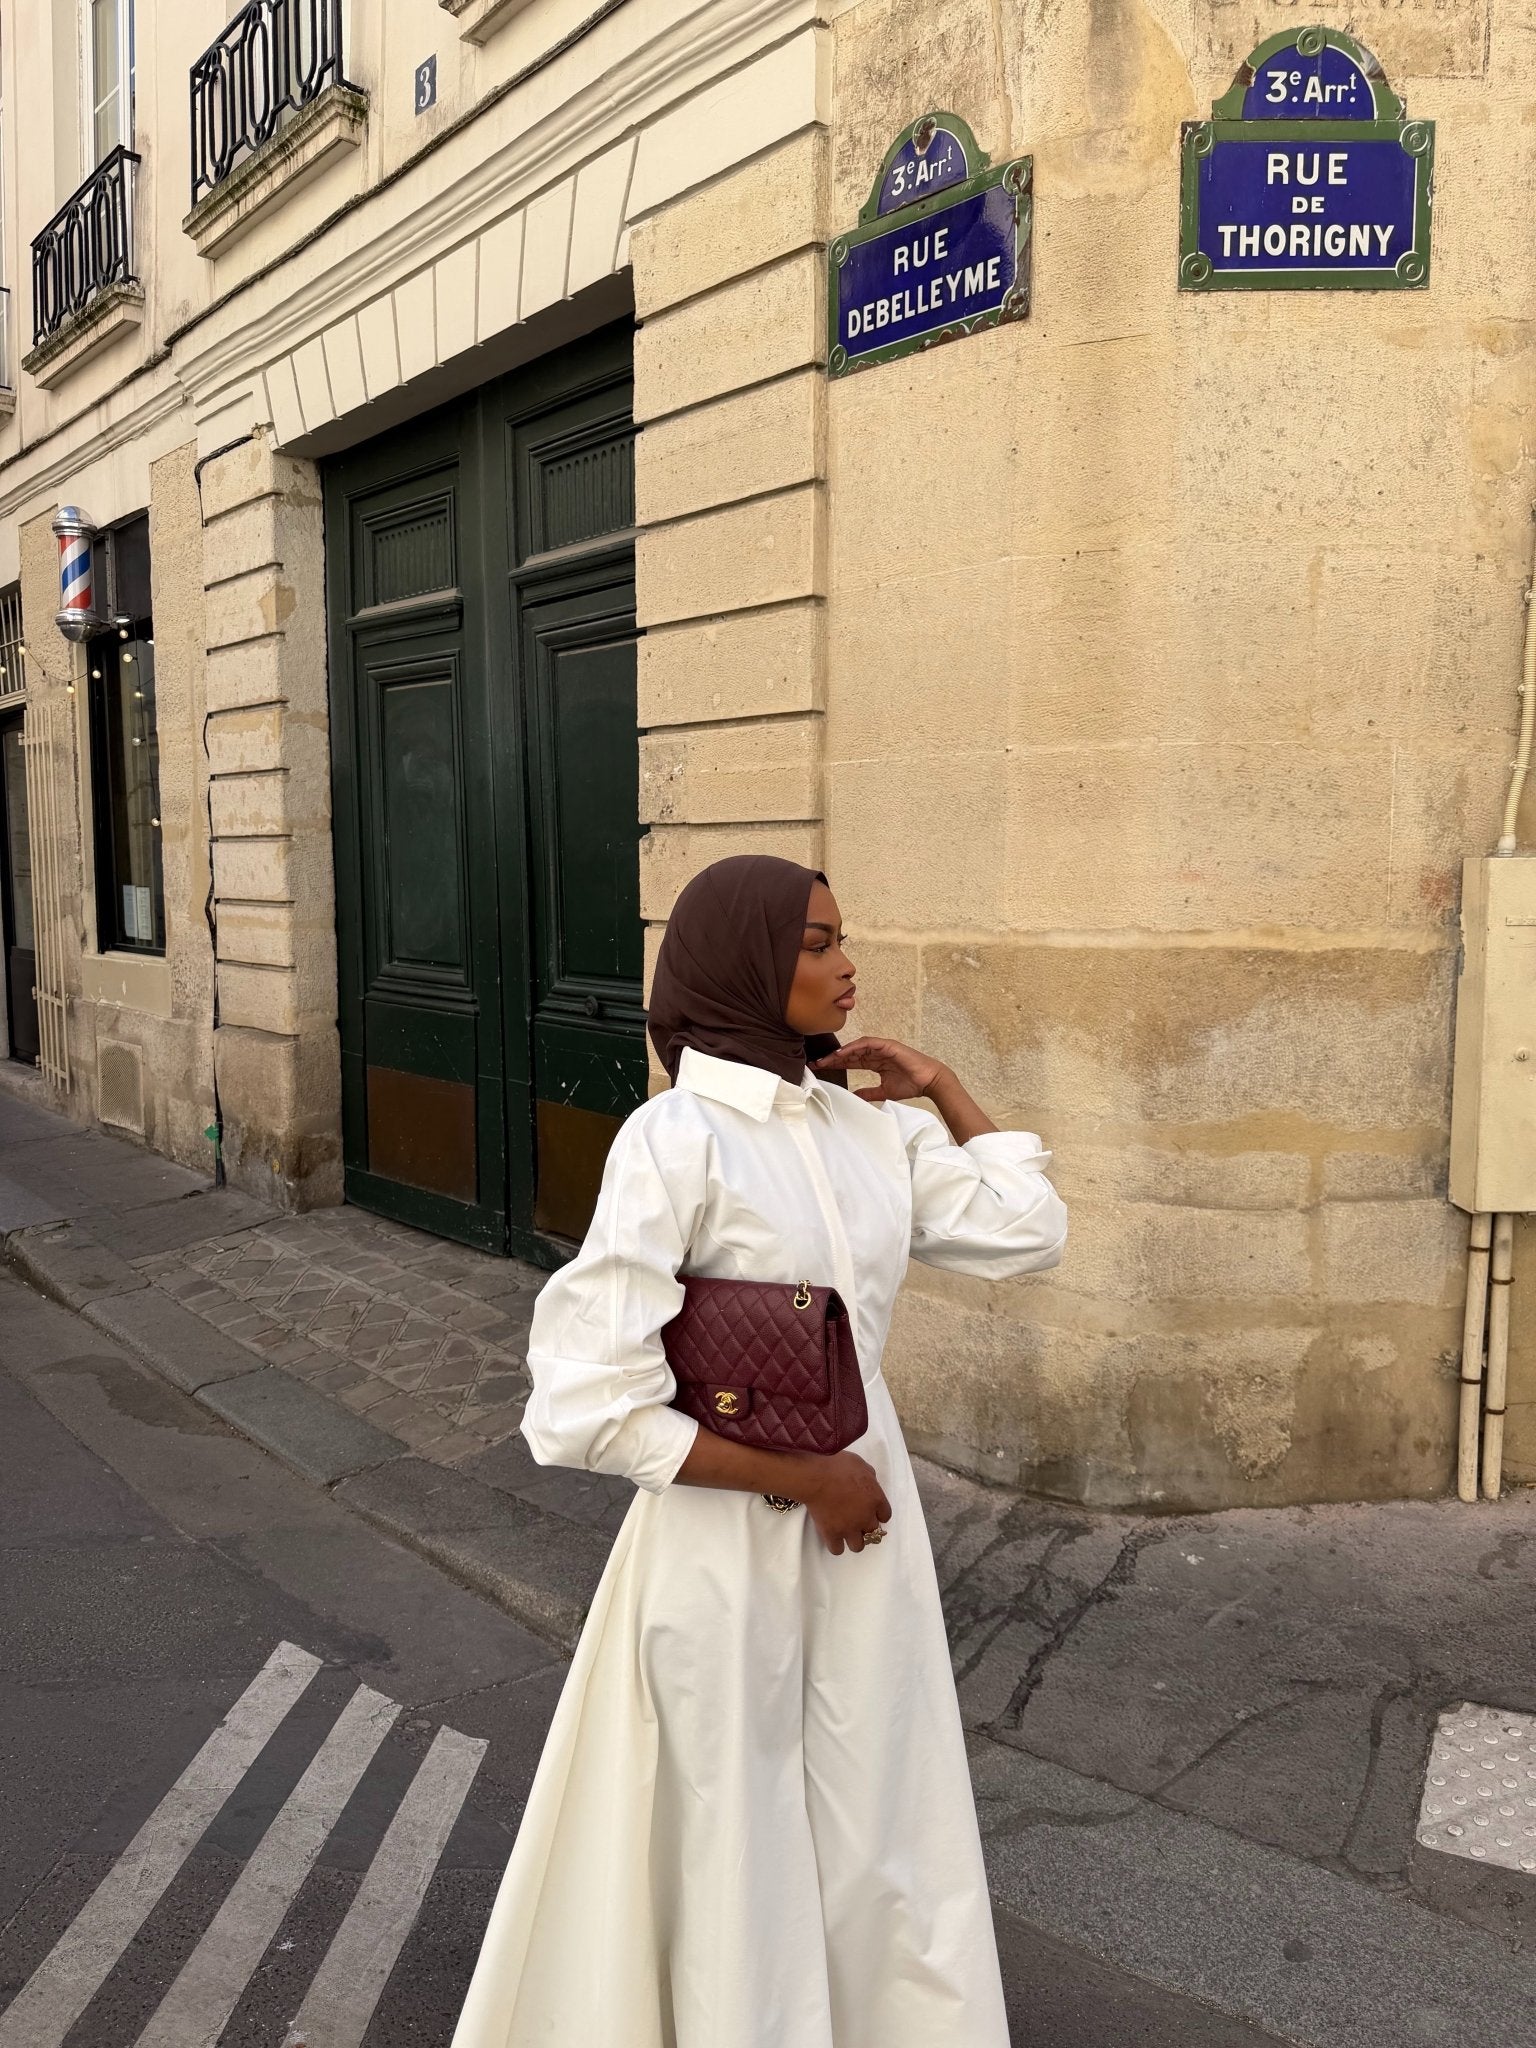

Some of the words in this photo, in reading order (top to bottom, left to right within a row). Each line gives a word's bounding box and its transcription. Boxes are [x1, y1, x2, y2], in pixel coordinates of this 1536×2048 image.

[419, 66, 431, 107] 3
[1267, 153, 1348, 185] RUE
[1292, 196, 1325, 214] DE
[893, 227, 949, 276] RUE
[1217, 224, 1395, 257] THORIGNY
[847, 255, 1001, 339] DEBELLEYME
